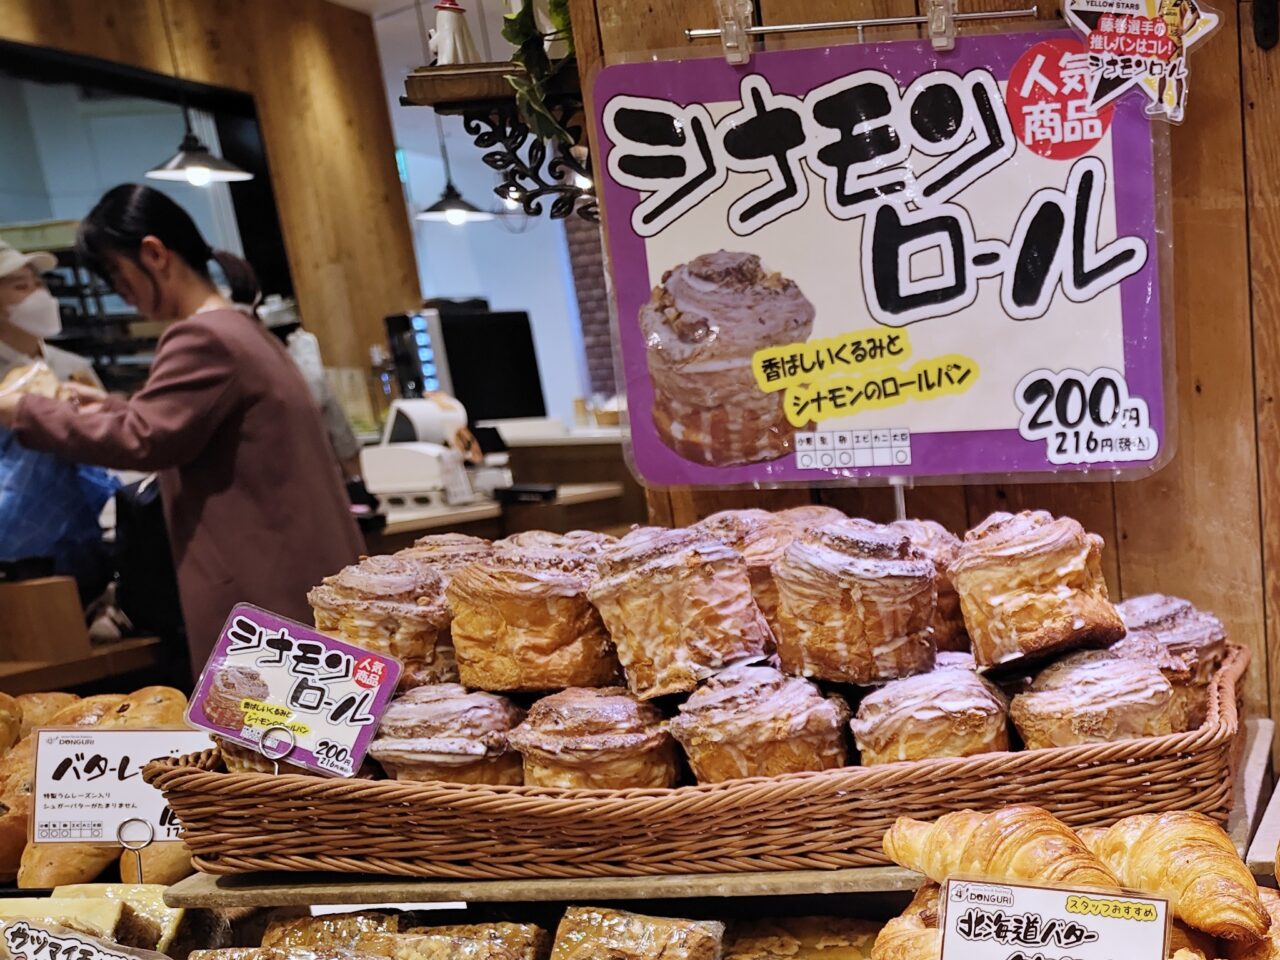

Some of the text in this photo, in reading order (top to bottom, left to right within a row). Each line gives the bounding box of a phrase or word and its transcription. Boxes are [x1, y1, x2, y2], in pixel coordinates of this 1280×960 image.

[1116, 2, 1139, 10] STARS
[1020, 52, 1093, 99] 人気
[1089, 55, 1186, 77] シナモンロール
[1022, 100, 1102, 145] 商品
[608, 76, 1011, 230] シナモン
[866, 163, 1143, 320] ロール
[762, 335, 903, 382] 香ばしいくるみと
[793, 364, 971, 415] シナモンのロールパン
[1023, 377, 1139, 430] 200円
[228, 617, 352, 682] シナモン
[359, 658, 385, 675] 人気
[354, 670, 380, 686] 商品
[289, 678, 373, 724] ロール
[316, 741, 351, 766] 200円
[970, 893, 1011, 904] DONGURI
[1069, 900, 1154, 917] スタッフおすすめ
[957, 909, 1098, 947] 北海道バター
